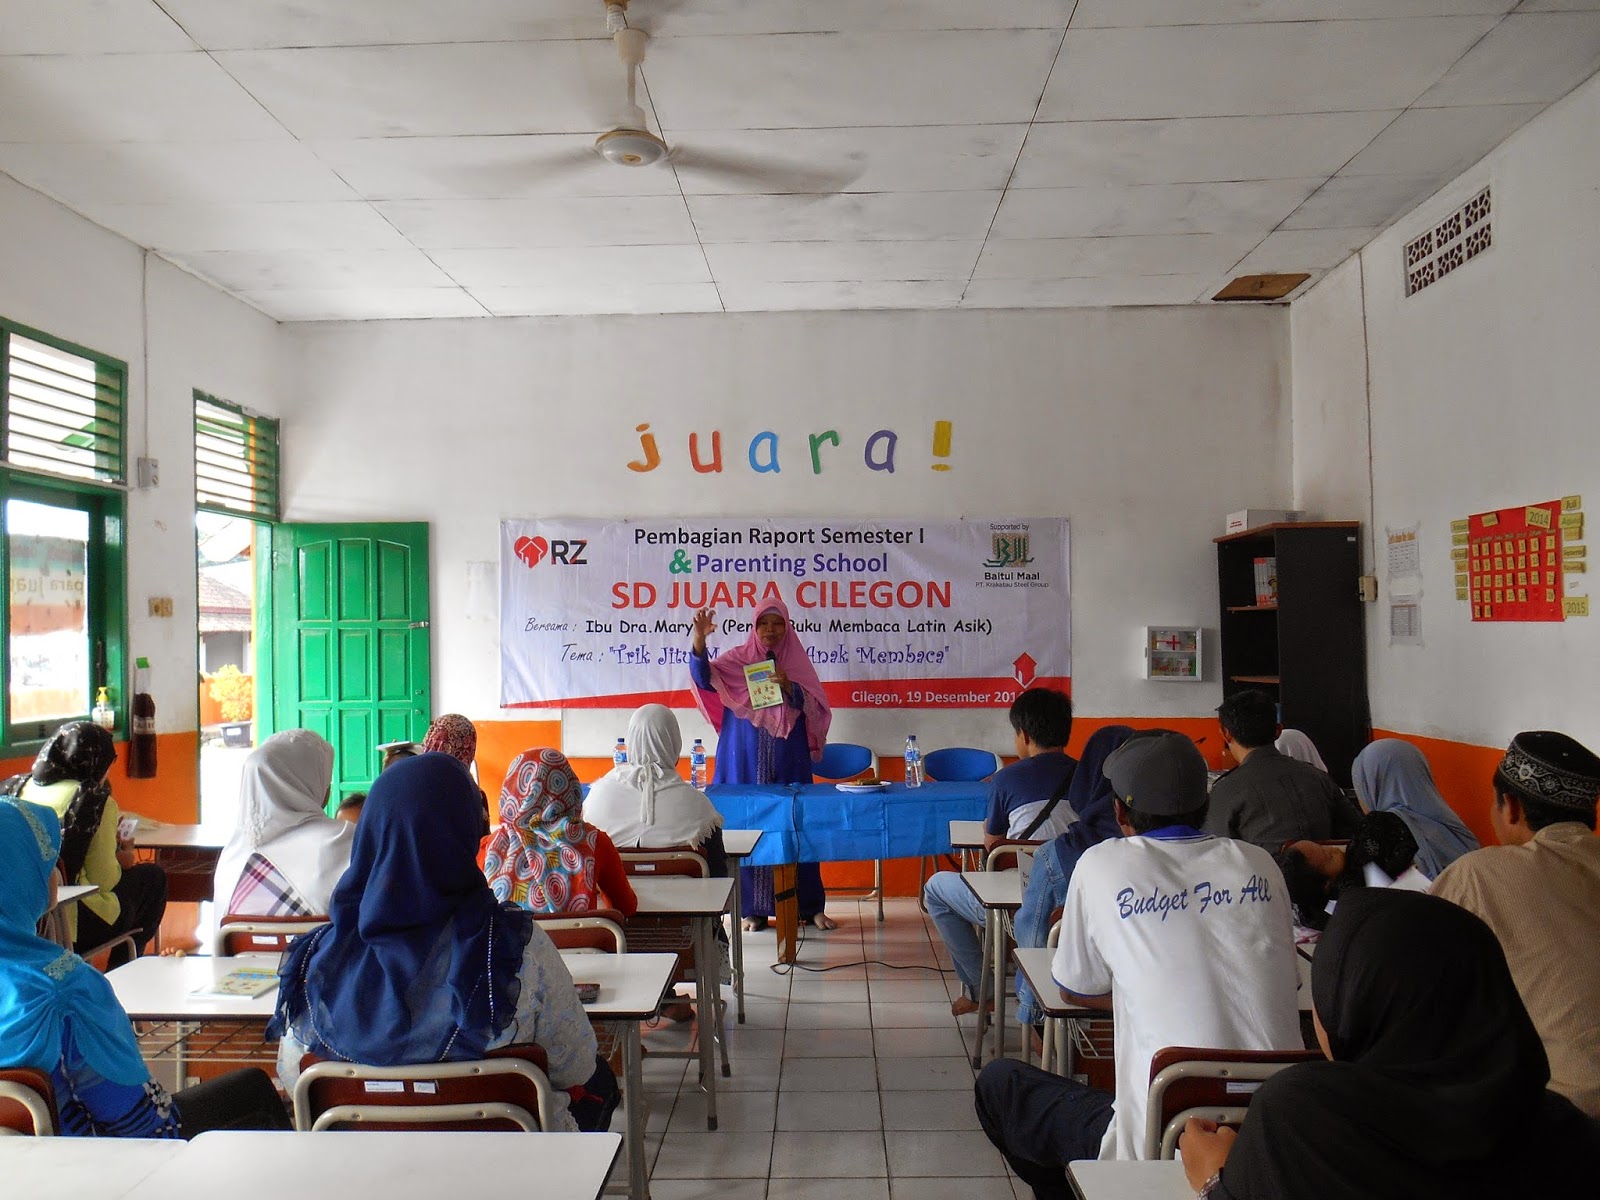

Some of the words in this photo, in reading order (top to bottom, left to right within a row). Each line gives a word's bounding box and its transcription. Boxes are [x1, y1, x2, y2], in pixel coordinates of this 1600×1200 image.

[627, 420, 953, 473] juara!
[1529, 511, 1549, 524] 2014
[634, 528, 742, 548] Pembagian
[750, 528, 815, 547] Raport
[821, 528, 913, 544] Semester
[551, 540, 588, 565] RZ
[669, 549, 692, 574] &
[697, 553, 806, 577] Parenting
[813, 553, 887, 572] School
[984, 572, 1013, 580] Baitul
[1017, 572, 1040, 580] Maal
[611, 581, 657, 609] SD
[667, 581, 782, 609] JUARA
[796, 580, 951, 609] CILEGON
[1566, 602, 1586, 614] 2015
[525, 617, 568, 632] Bersama
[585, 620, 612, 633] Ibu
[829, 618, 900, 633] Membaca
[907, 618, 946, 633] Latin
[953, 618, 992, 635] Asik)
[561, 643, 592, 662] Tema
[806, 643, 849, 664] Anak
[856, 644, 949, 664] Membaca"
[852, 691, 902, 704] Cilegon,
[906, 691, 922, 702] 19
[925, 691, 990, 703] Desember
[994, 691, 1024, 702] 201
[1117, 887, 1188, 921] Budget
[1194, 881, 1232, 913] For
[1240, 874, 1273, 904] All
